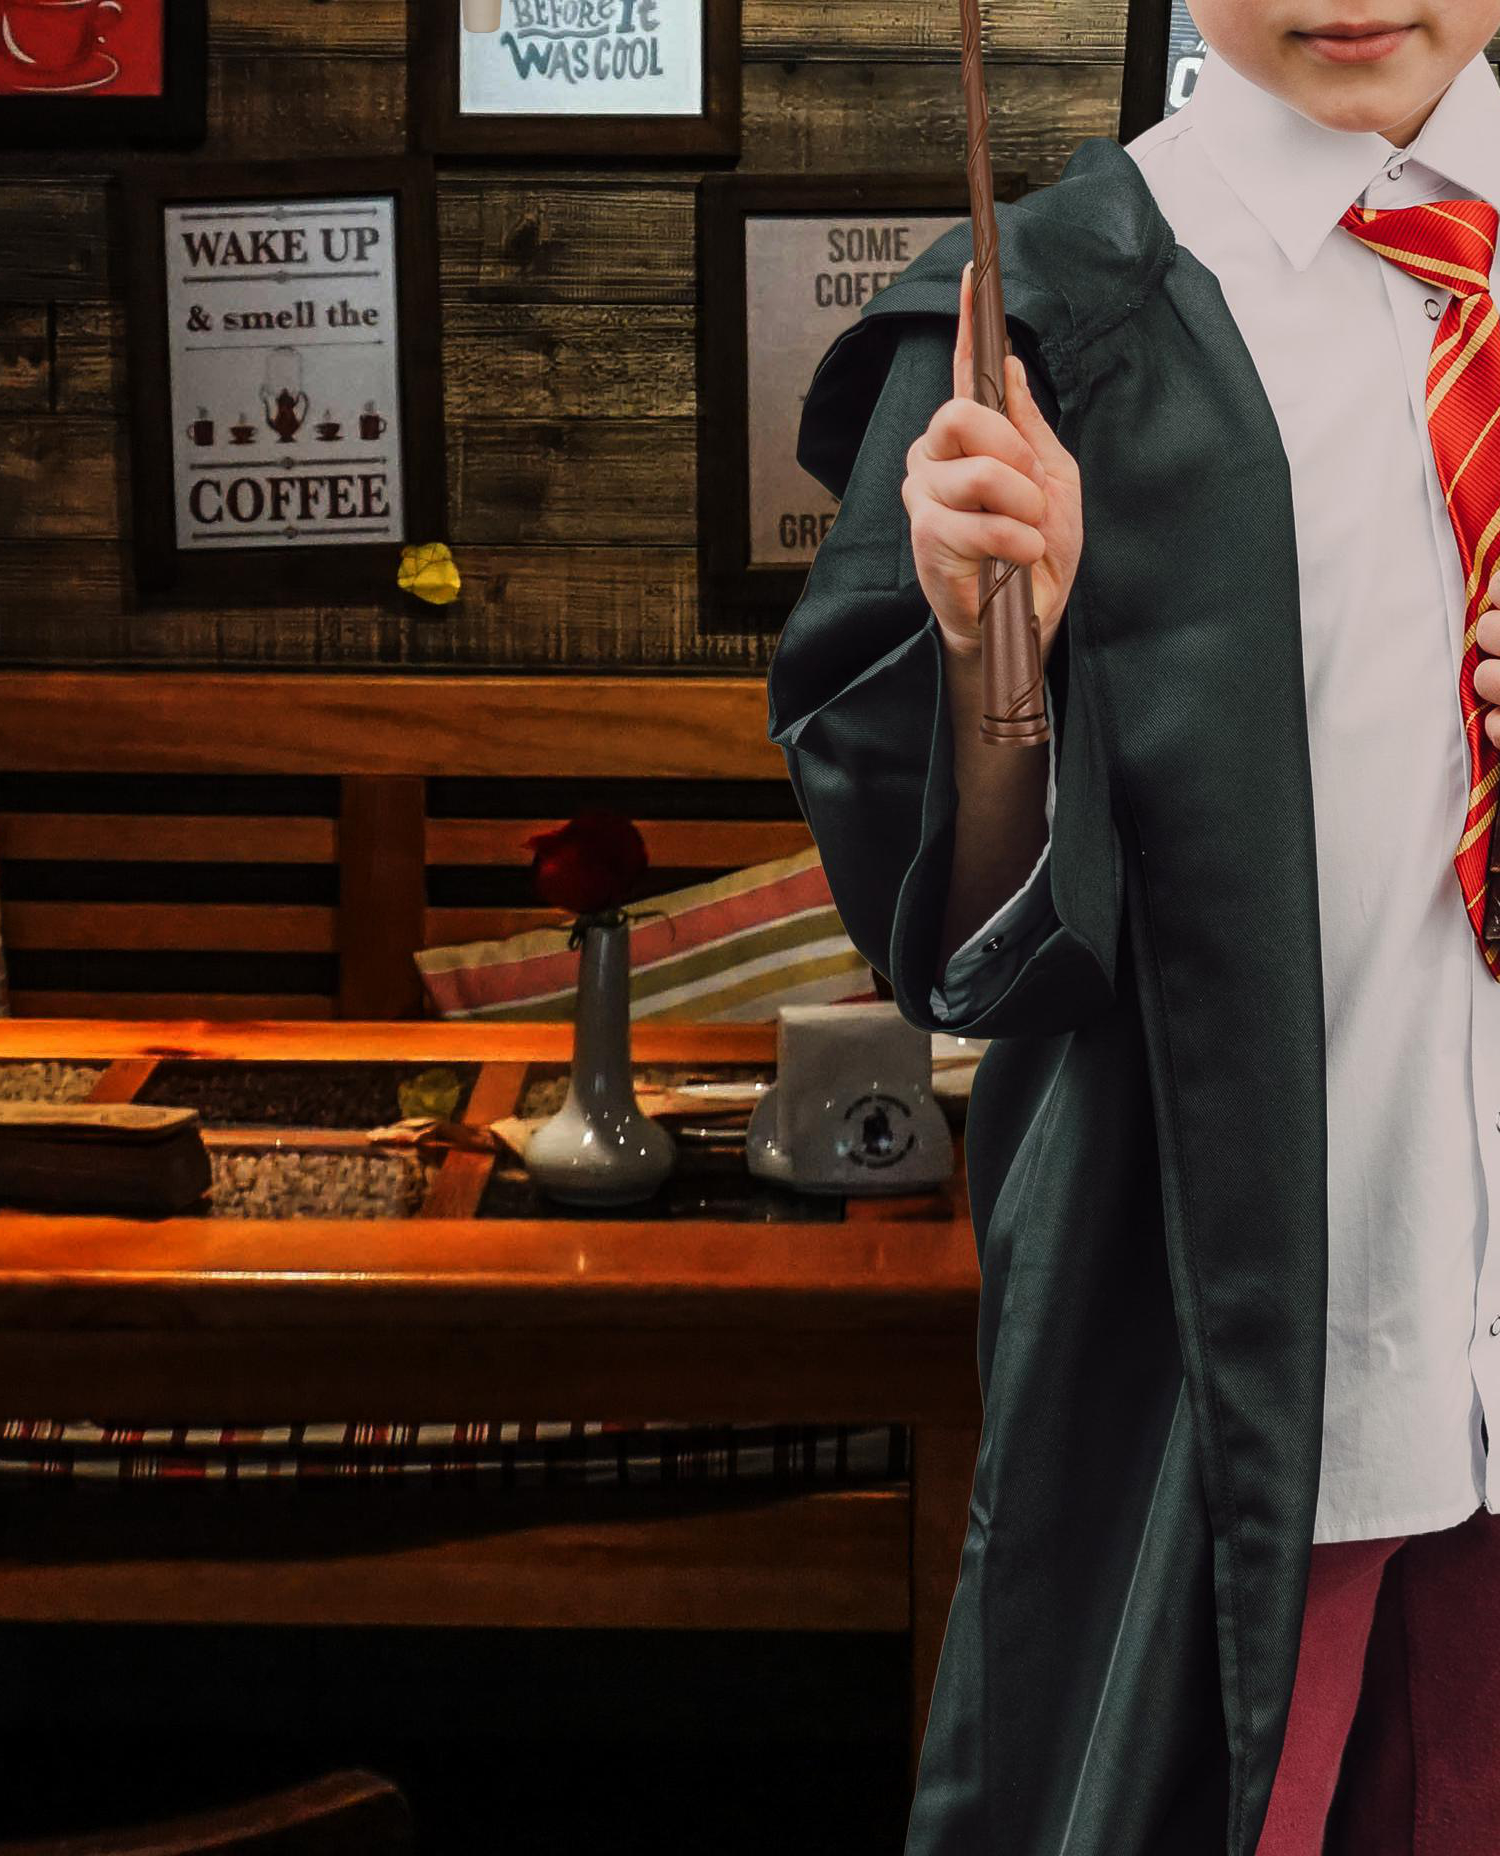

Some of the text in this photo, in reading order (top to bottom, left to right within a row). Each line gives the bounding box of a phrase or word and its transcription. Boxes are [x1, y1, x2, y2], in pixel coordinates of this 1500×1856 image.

[501, 31, 663, 84] WAS COOL
[181, 227, 380, 267] WAKE UP
[828, 227, 911, 263] SOME
[815, 271, 901, 307] COFF
[187, 299, 379, 332] & smell the
[189, 473, 390, 524] COFFEE
